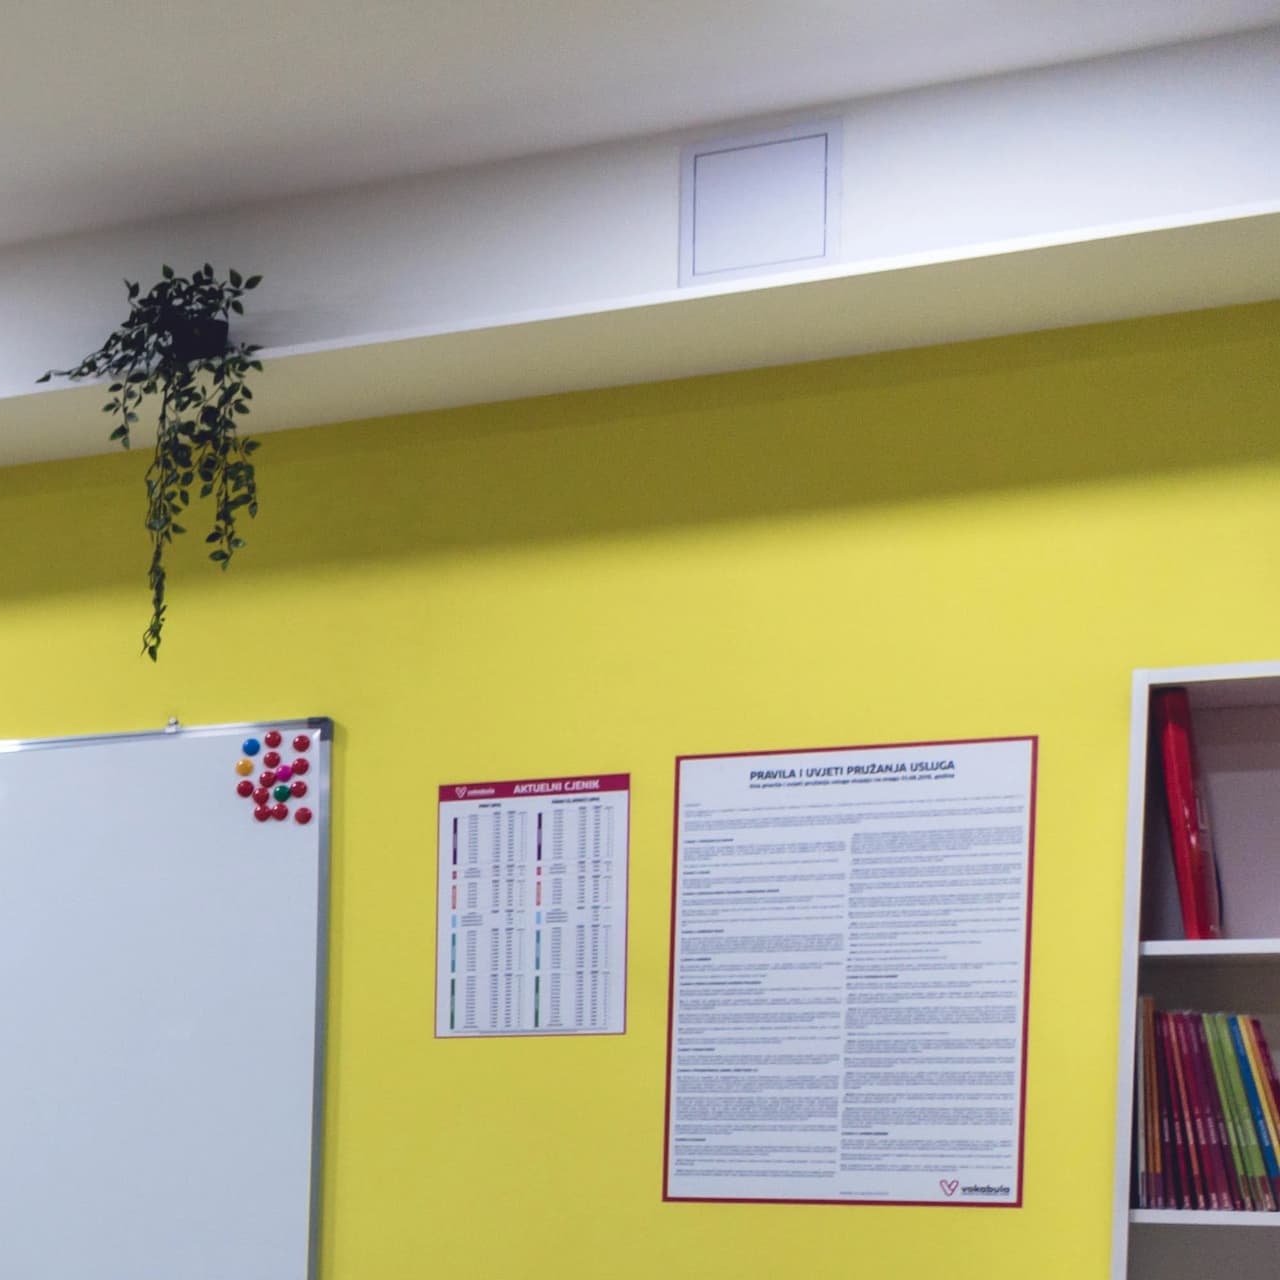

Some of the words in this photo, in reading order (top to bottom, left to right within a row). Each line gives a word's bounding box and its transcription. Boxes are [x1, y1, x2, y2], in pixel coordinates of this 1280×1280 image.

[750, 770, 795, 781] PRAVILA
[806, 767, 843, 777] UVJETI
[847, 762, 906, 775] PRUŽANJA
[910, 760, 955, 771] USLUGA
[513, 784, 562, 795] AKTUELNI
[564, 780, 600, 791] CJENIK
[961, 1184, 1010, 1194] vokabula
